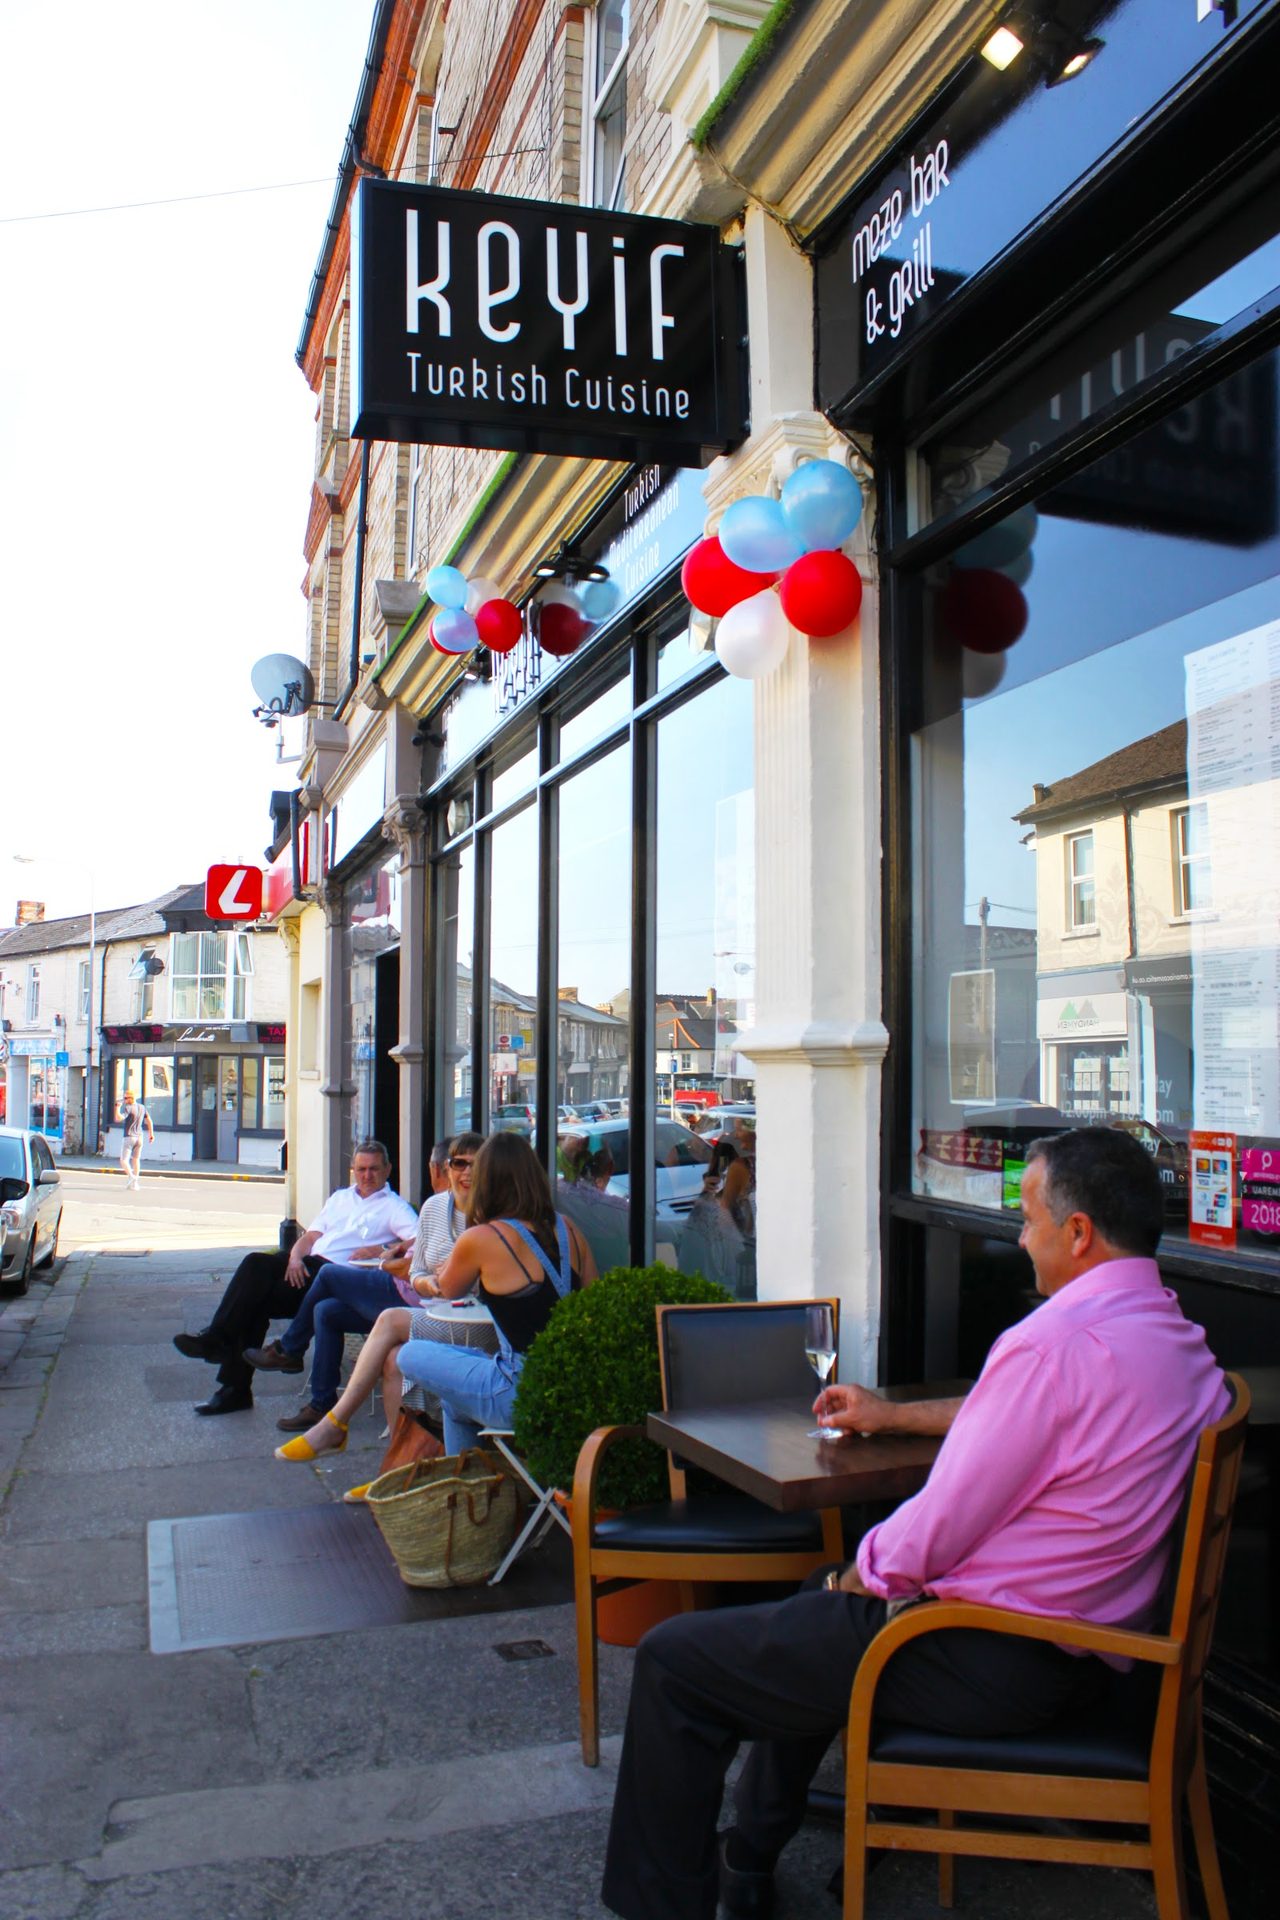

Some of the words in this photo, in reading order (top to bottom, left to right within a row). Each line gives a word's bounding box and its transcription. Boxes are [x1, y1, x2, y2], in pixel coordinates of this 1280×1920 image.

[866, 287, 886, 345] &
[406, 352, 547, 406] Turkish
[565, 368, 690, 420] Cuisine
